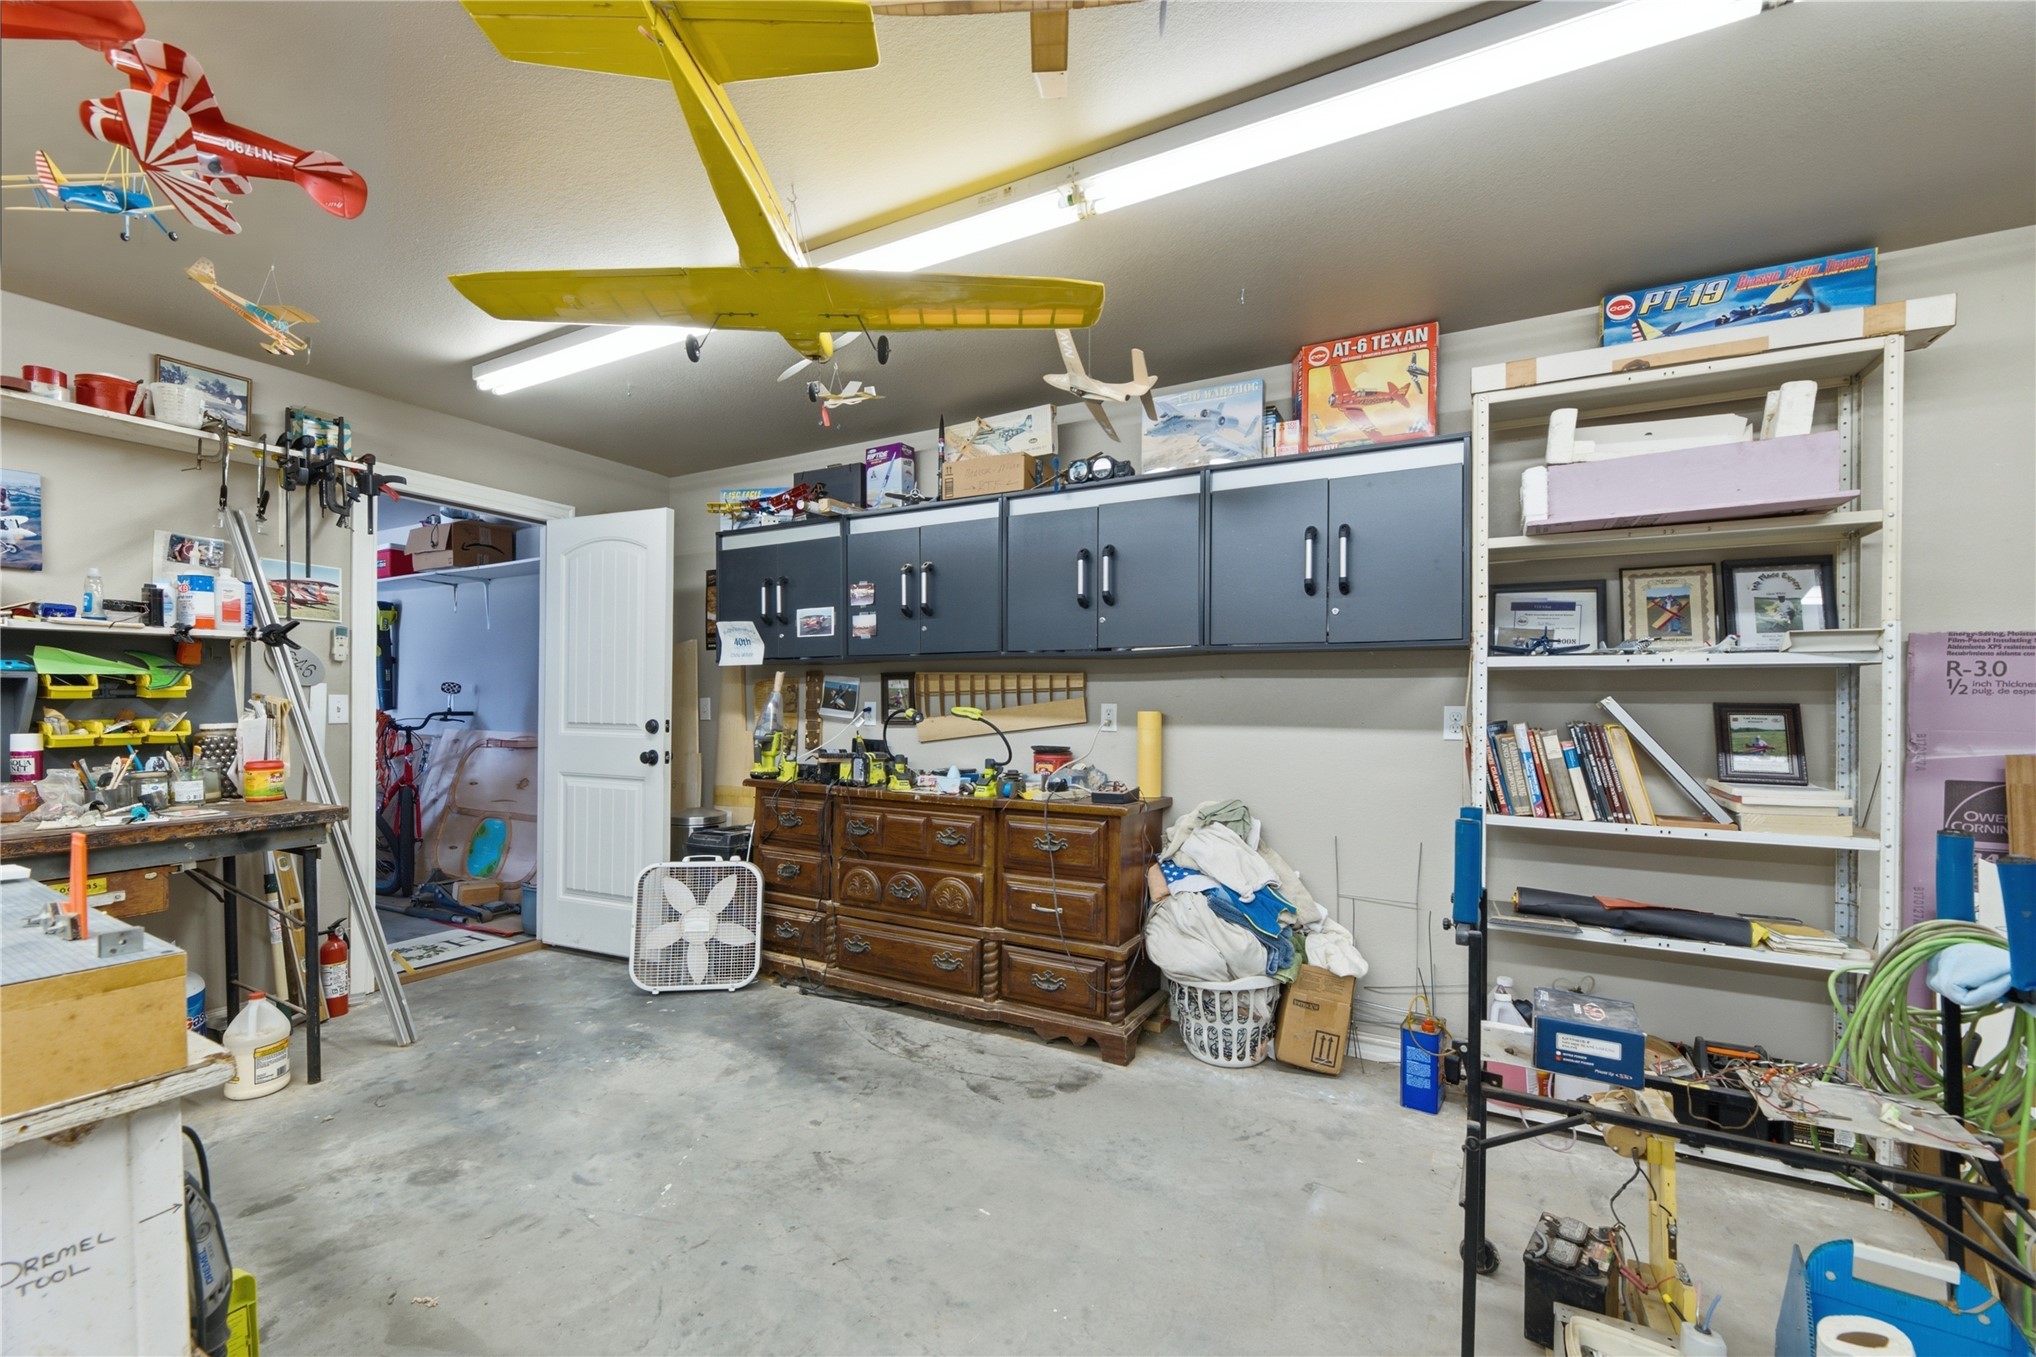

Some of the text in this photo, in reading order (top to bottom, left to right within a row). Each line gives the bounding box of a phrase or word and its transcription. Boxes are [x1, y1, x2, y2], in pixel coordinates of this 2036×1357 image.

[225, 139, 274, 162] N1790
[1638, 279, 1730, 316] PT-19
[1609, 303, 1632, 312] COX
[1790, 307, 1804, 318] 26
[1332, 326, 1429, 358] AT-6 TEXAN
[1204, 381, 1259, 400] WARTHOG
[734, 637, 752, 647] 40th
[1946, 660, 2008, 677] R-3.0
[1972, 680, 1992, 688] inch
[1972, 688, 1995, 696] pulg.
[1997, 687, 2010, 695] de
[1515, 769, 1528, 797] MAKING
[1950, 821, 2009, 834] CORNIN
[442, 935, 487, 948] H
[197, 1246, 214, 1287] DREMEL
[16, 1263, 91, 1298] TOOL
